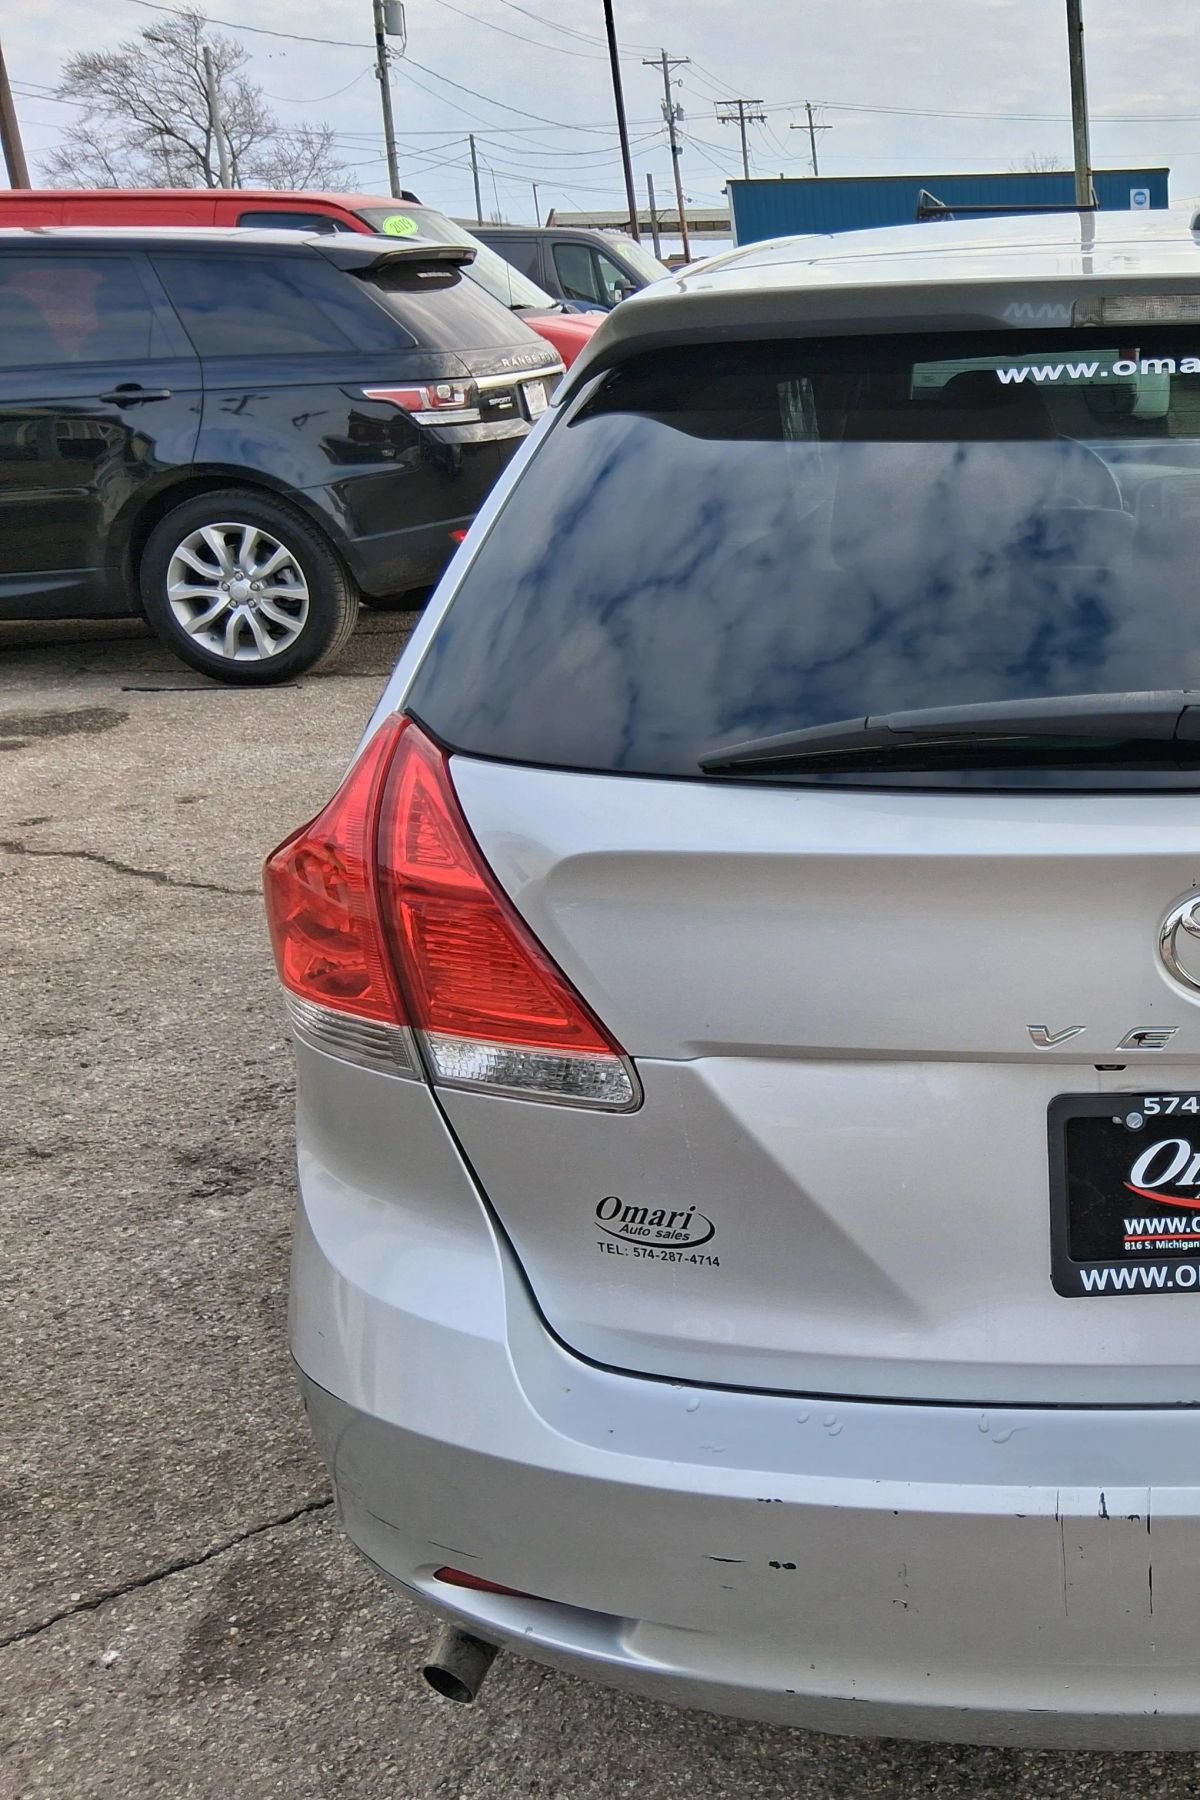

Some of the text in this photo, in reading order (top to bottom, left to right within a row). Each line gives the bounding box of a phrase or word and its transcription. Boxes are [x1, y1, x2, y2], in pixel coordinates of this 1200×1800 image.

[501, 354, 537, 368] RANGE
[595, 1196, 697, 1231] Omari
[619, 1223, 691, 1241] Auto sales
[1124, 1241, 1142, 1250] 816
[1144, 1241, 1154, 1250] S.
[1156, 1239, 1200, 1251] Michigan
[597, 1241, 720, 1268] TEL: 574-287-4714
